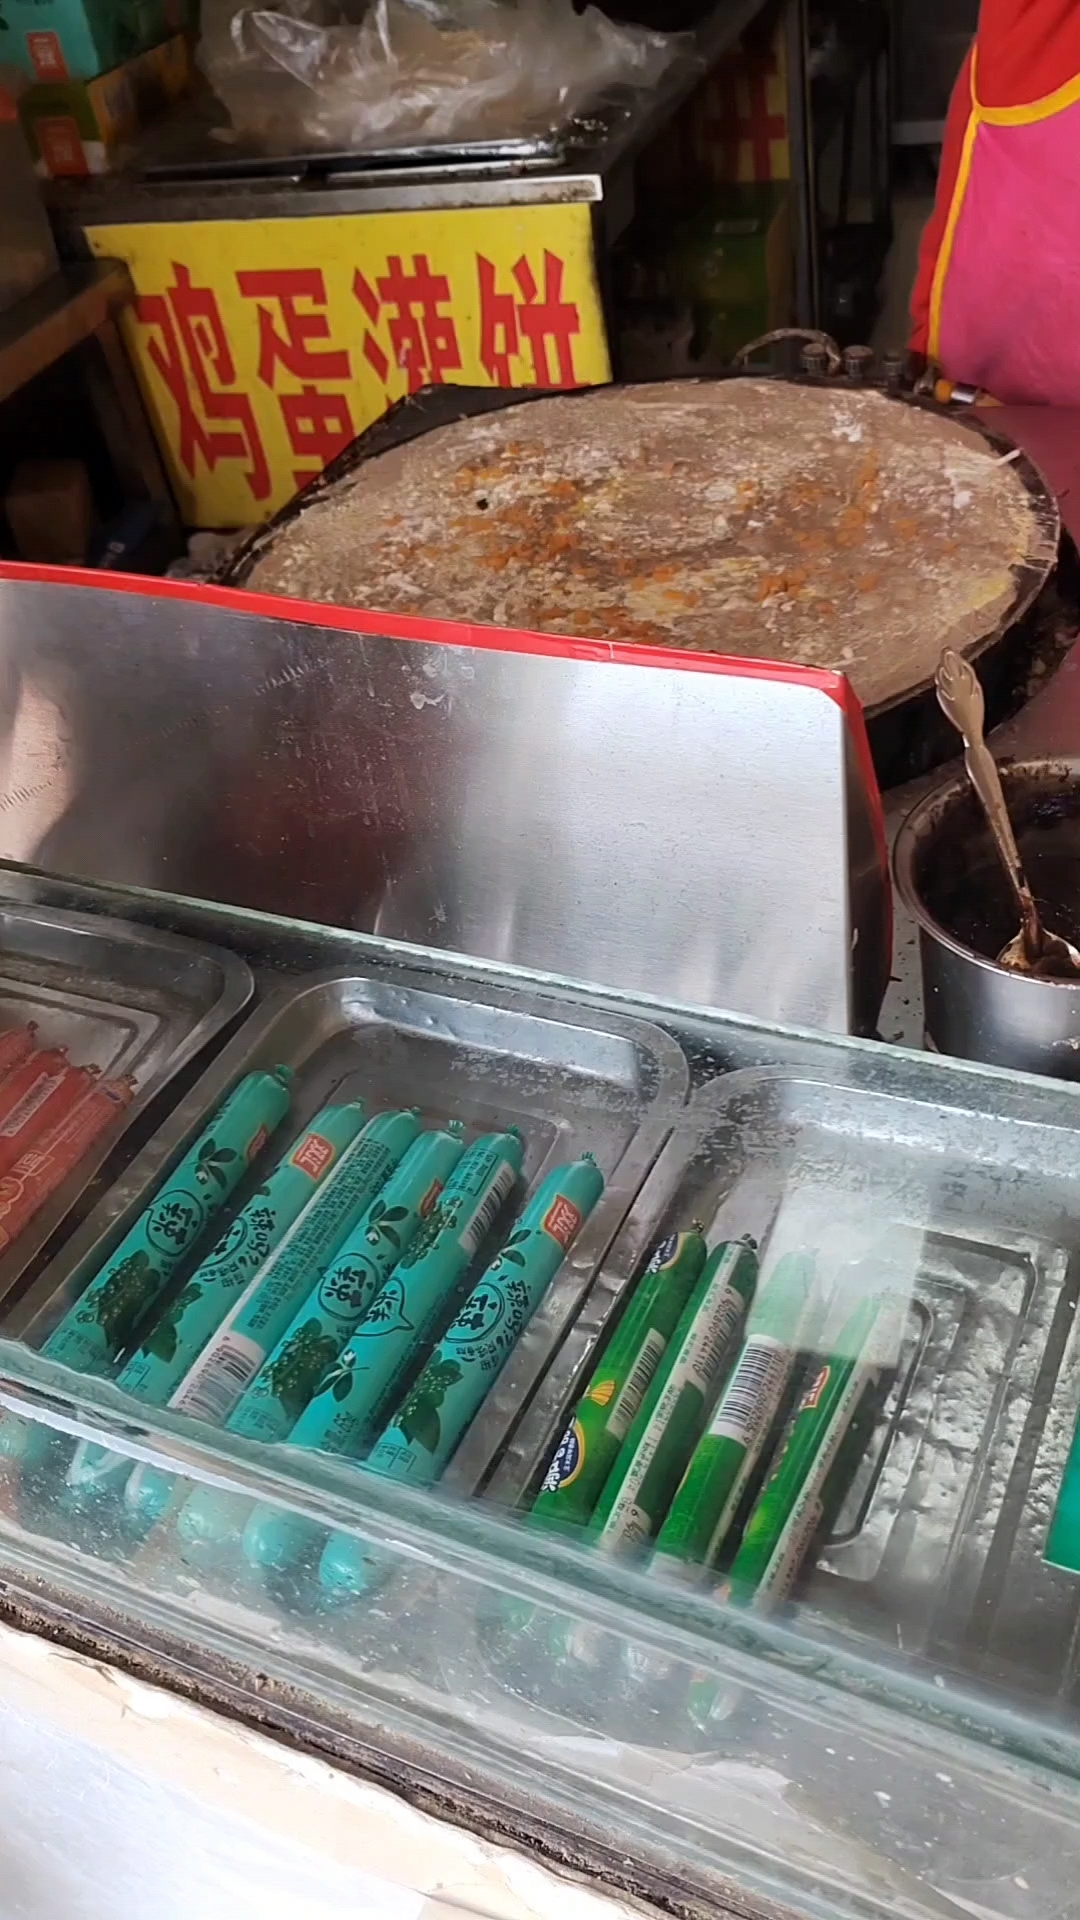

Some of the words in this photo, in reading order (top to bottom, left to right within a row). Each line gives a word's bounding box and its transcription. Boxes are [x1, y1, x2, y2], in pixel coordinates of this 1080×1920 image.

[299, 1139, 330, 1171] 双汇
[151, 1203, 197, 1244] 辣
[553, 1205, 579, 1244] 双汇
[324, 1266, 372, 1308] 辣
